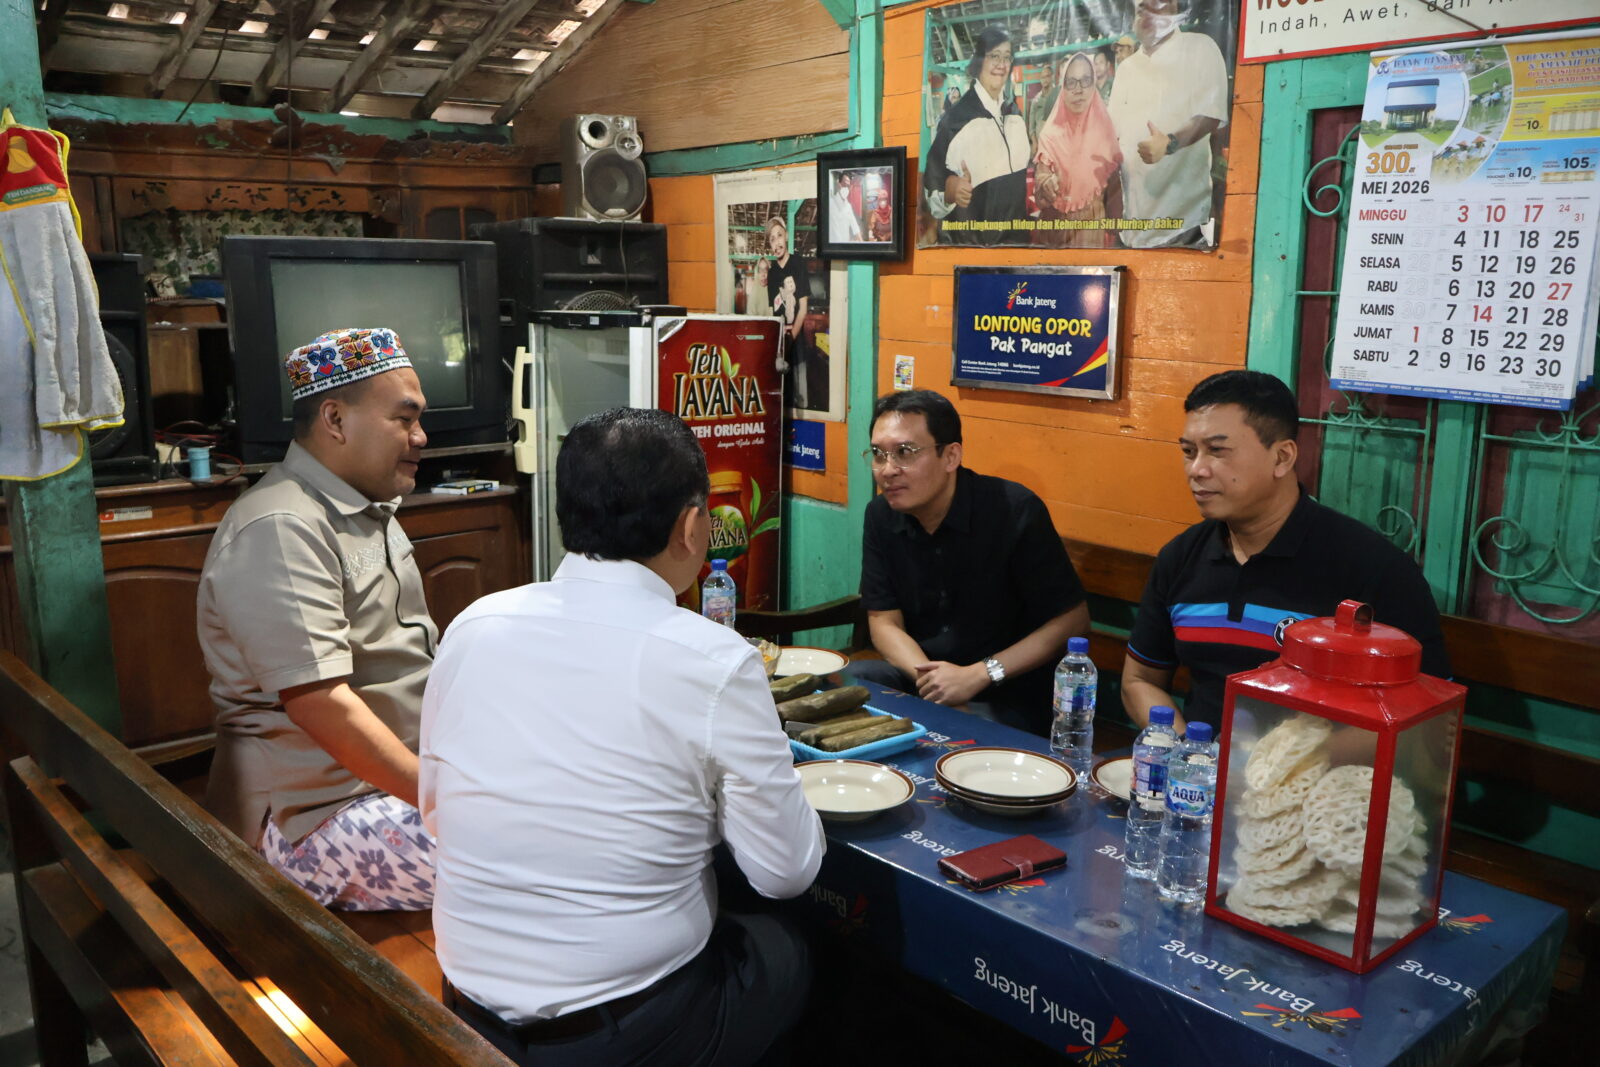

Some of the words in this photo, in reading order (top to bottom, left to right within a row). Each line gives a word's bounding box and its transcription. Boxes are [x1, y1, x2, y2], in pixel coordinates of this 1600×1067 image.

[1260, 13, 1327, 35] Indah,
[1343, 3, 1408, 23] Awet,
[1526, 119, 1540, 130] 10
[1366, 151, 1411, 174] 300
[1517, 166, 1532, 178] 10
[1563, 156, 1590, 169] 105
[1361, 181, 1387, 195] MEI
[1391, 180, 1430, 194] 2026
[1359, 209, 1407, 221] MINGGU
[1457, 204, 1469, 223] 3
[1486, 204, 1506, 223] 10
[1524, 204, 1544, 223] 17
[1559, 204, 1570, 213] 24
[1574, 212, 1585, 222] 31
[942, 219, 969, 231] Menteri
[970, 219, 1011, 232] Lingkungan
[1013, 219, 1036, 231] Hidup
[1037, 219, 1053, 230] dan
[1054, 219, 1099, 230] Kehutanan
[1100, 218, 1115, 230] Siti
[1116, 218, 1154, 231] Nurbaya
[1154, 217, 1184, 230] Bakar
[1371, 233, 1404, 245] SENIN
[1453, 230, 1466, 248] 4
[1483, 230, 1500, 248] 11
[1519, 230, 1539, 249] 18
[1553, 230, 1580, 249] 25
[1360, 256, 1401, 269] SELASA
[1451, 255, 1463, 272] 5
[1480, 255, 1499, 273] 12
[1516, 255, 1536, 274] 19
[1550, 256, 1576, 275] 26
[1367, 280, 1398, 292] RABU
[1448, 279, 1460, 297] 6
[1476, 280, 1495, 298] 13
[1508, 281, 1535, 299] 20
[1547, 283, 1573, 300] 27
[1015, 295, 1033, 306] Bank
[1034, 296, 1057, 309] Jateng
[974, 314, 1042, 334] LONTONG
[1045, 317, 1092, 337] OPOR
[1360, 304, 1395, 316] KAMIS
[1446, 304, 1457, 321] 7
[1473, 305, 1493, 323] 14
[1506, 306, 1529, 324] 21
[1542, 308, 1569, 326] 28
[990, 336, 1016, 353] Pak
[1020, 337, 1072, 358] Pangat
[1353, 327, 1392, 340] JUMAT
[1412, 326, 1420, 343] 1
[1441, 328, 1454, 346] 8
[1470, 329, 1489, 347] 15
[1503, 331, 1528, 350] 22
[1539, 333, 1565, 352] 29
[687, 343, 722, 376] Teh
[1353, 349, 1389, 363] SABTU
[1407, 350, 1419, 367] 2
[1439, 351, 1451, 369] 9
[1466, 353, 1486, 372] 16
[1499, 356, 1524, 374] 23
[1535, 358, 1562, 377] 30
[714, 421, 766, 437] ORIGINAL
[801, 444, 820, 460] Jateng
[1172, 786, 1205, 803] AQUA
[1160, 939, 1251, 981] Jateng
[974, 957, 1038, 1014] Jateng
[1243, 976, 1315, 1014] Bank
[1041, 996, 1096, 1046] Bank
